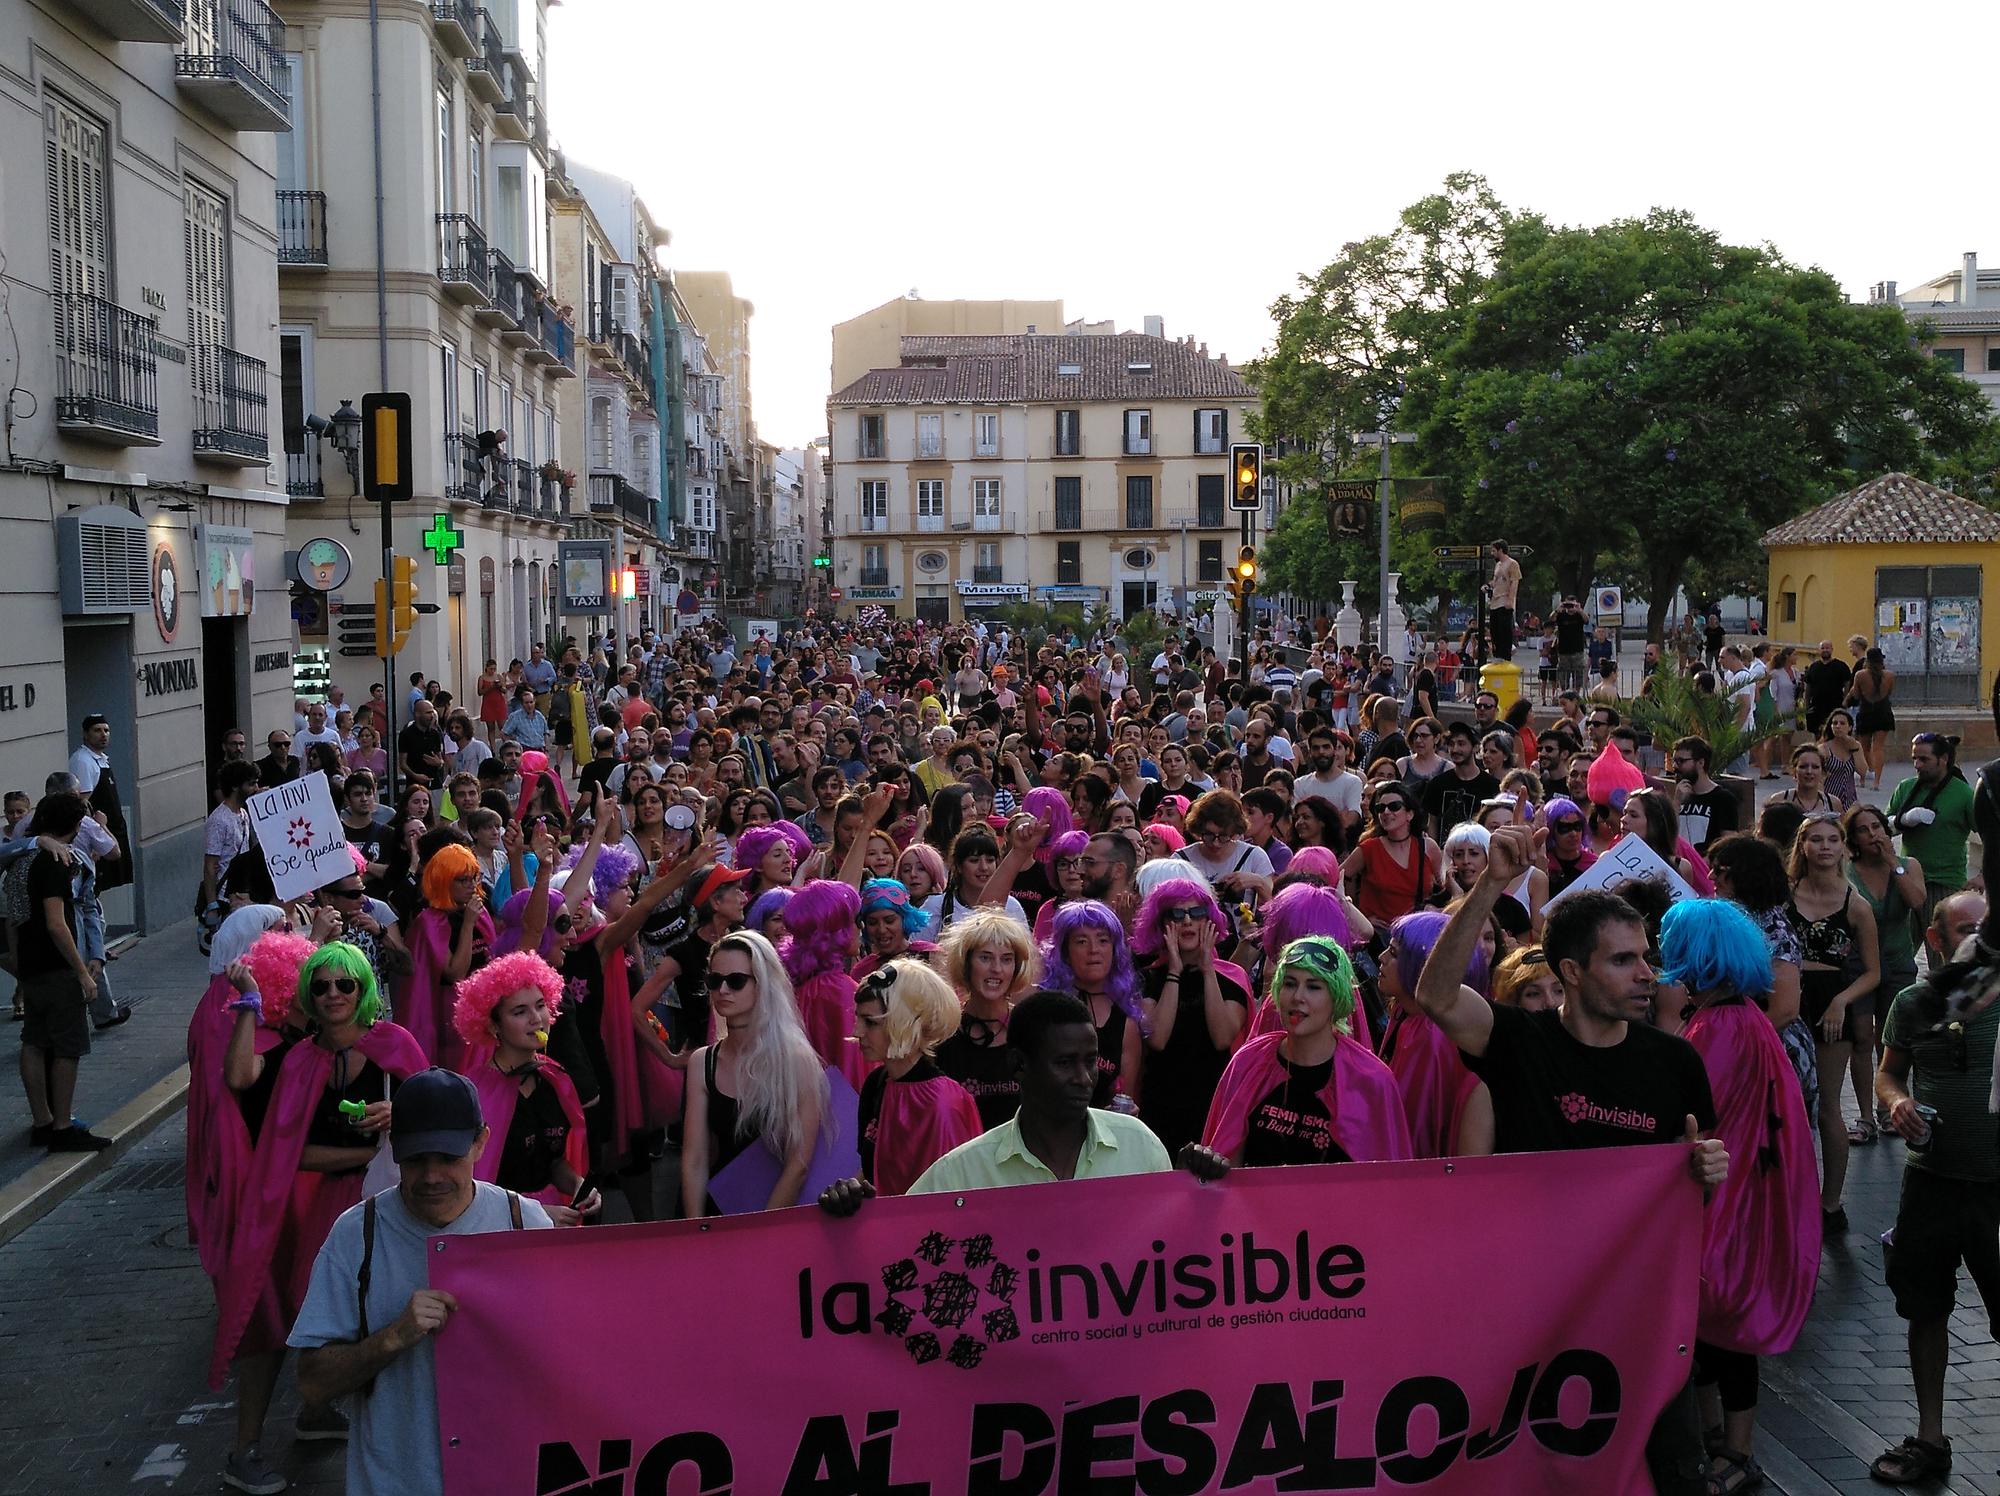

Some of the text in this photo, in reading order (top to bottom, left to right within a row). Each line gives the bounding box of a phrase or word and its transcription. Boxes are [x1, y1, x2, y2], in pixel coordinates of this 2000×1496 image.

[1328, 484, 1374, 502] ADDAMS
[570, 596, 601, 607] TAXI
[851, 589, 897, 599] FARMACIA
[964, 586, 1022, 594] Market
[144, 658, 199, 697] NONNA
[1588, 1102, 1656, 1130] invisible
[798, 1230, 1367, 1339] la invisible
[1032, 1305, 1367, 1344] centro social y cultural de gestión ciudadana
[780, 1409, 931, 1496] AL
[967, 1348, 1623, 1496] DESALOJO
